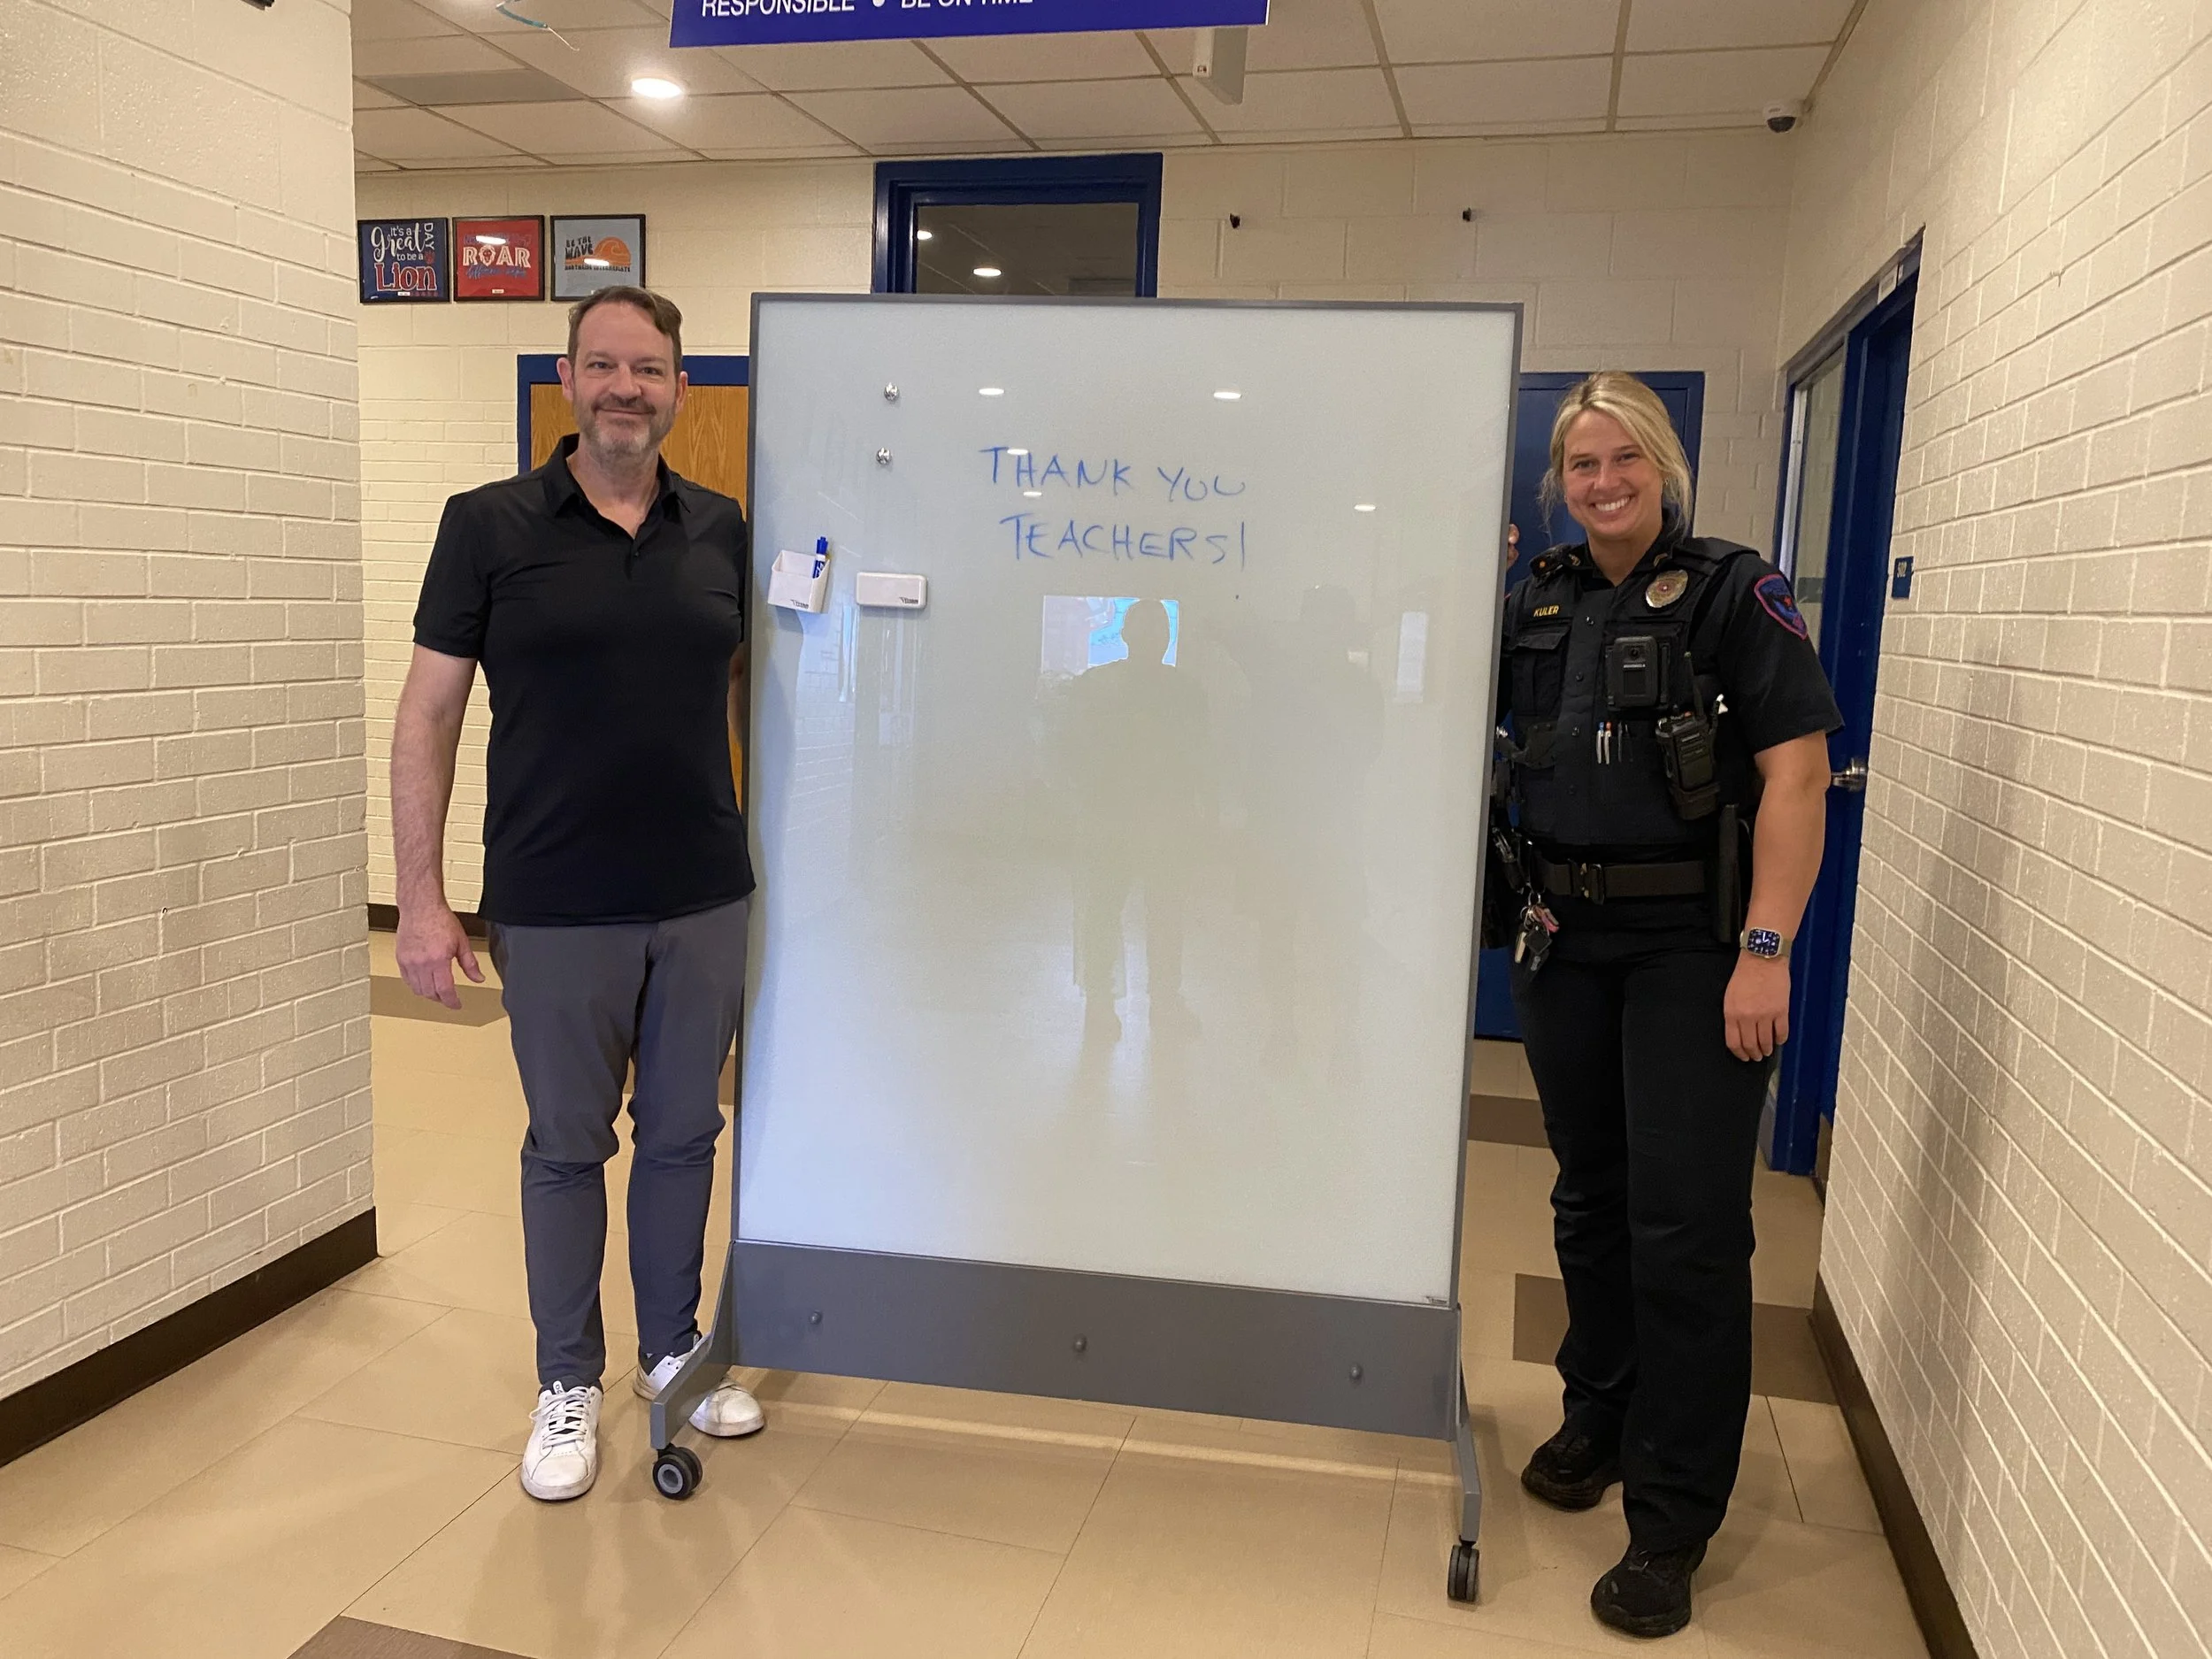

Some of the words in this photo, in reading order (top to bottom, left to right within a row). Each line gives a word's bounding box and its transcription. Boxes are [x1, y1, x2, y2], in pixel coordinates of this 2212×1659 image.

[371, 222, 425, 263] great
[424, 222, 434, 250] DAY
[407, 252, 417, 261] be
[463, 244, 531, 268] ROAR
[565, 243, 594, 260] WAVE
[374, 262, 437, 291] Lion
[978, 446, 1131, 495] THANK
[1157, 466, 1246, 502] YOU
[1533, 604, 1560, 618] KULER
